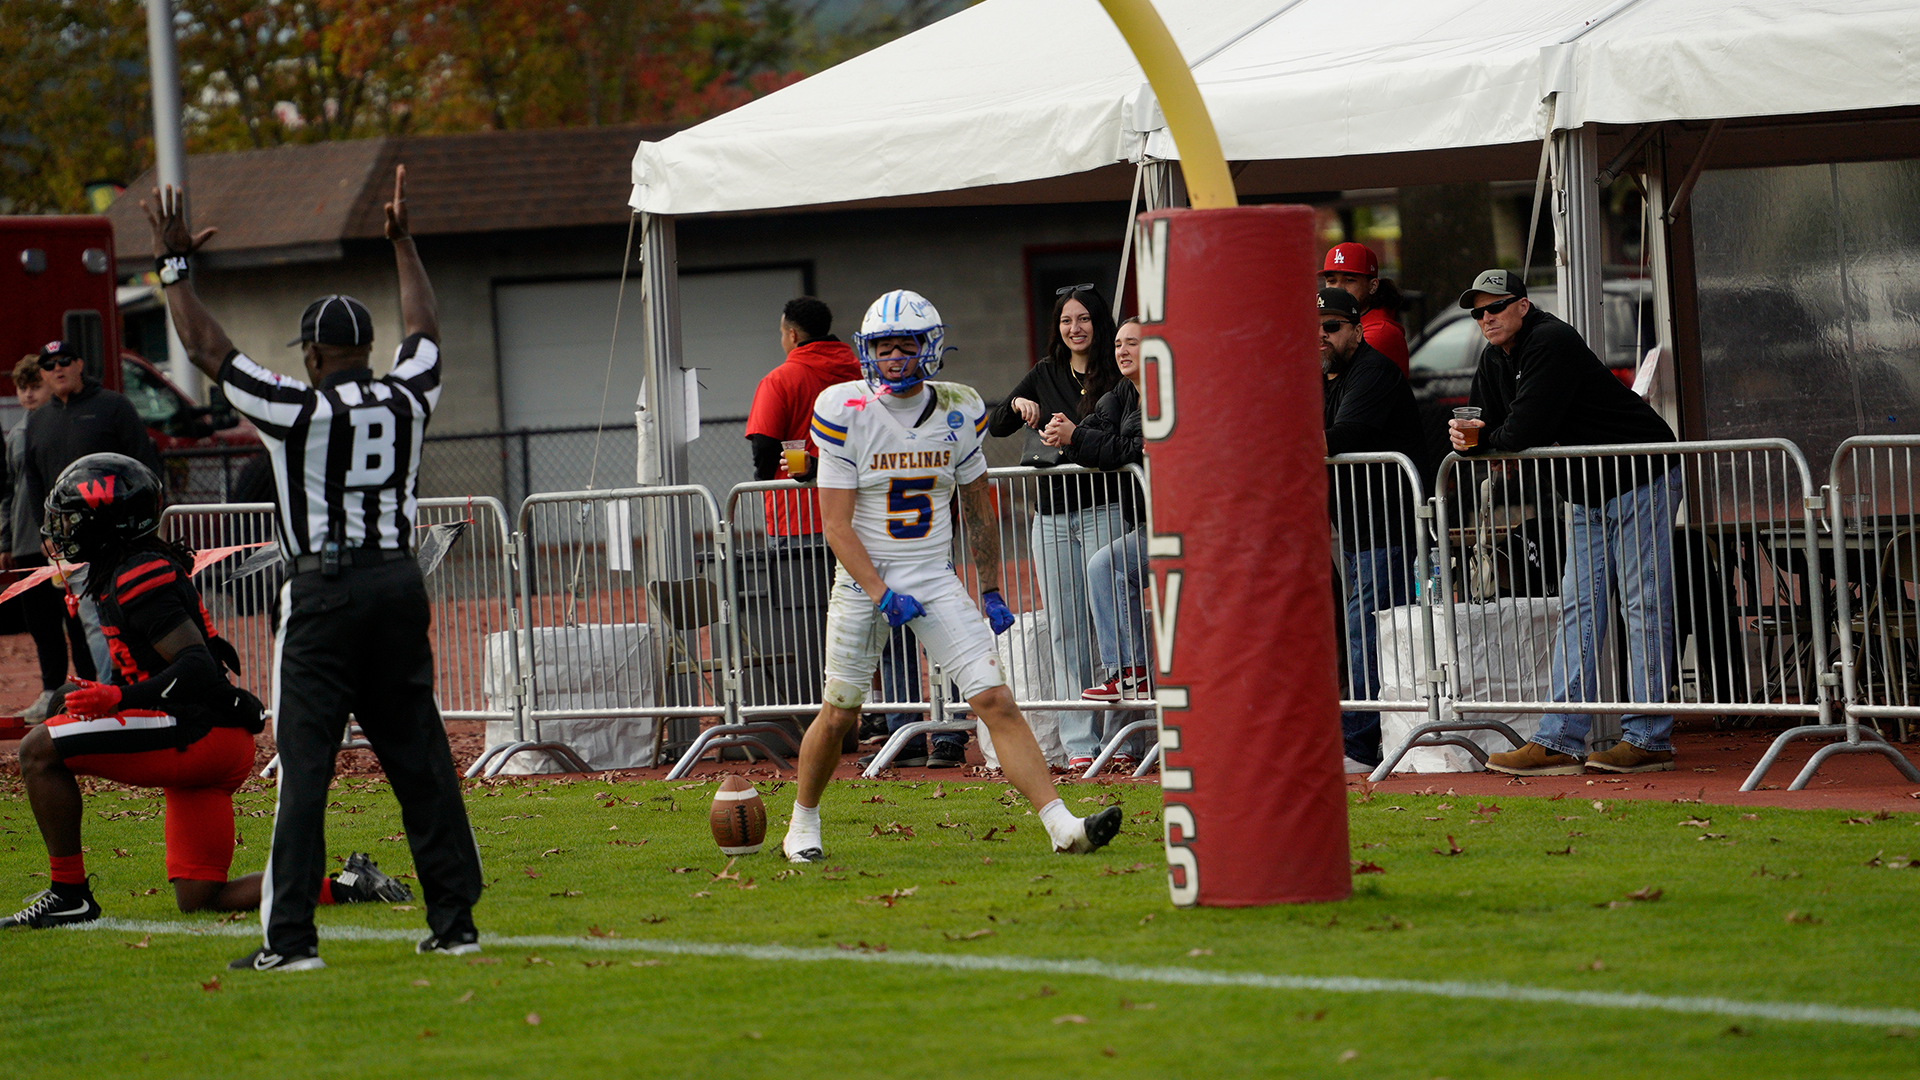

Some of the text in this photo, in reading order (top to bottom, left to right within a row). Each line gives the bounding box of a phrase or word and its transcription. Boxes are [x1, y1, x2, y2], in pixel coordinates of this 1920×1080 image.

[1333, 248, 1345, 264] LA
[344, 405, 396, 488] B
[869, 449, 951, 470] JAVELINAS
[76, 474, 115, 509] W
[886, 475, 938, 540] 5
[1134, 217, 1199, 908] WOLVES
